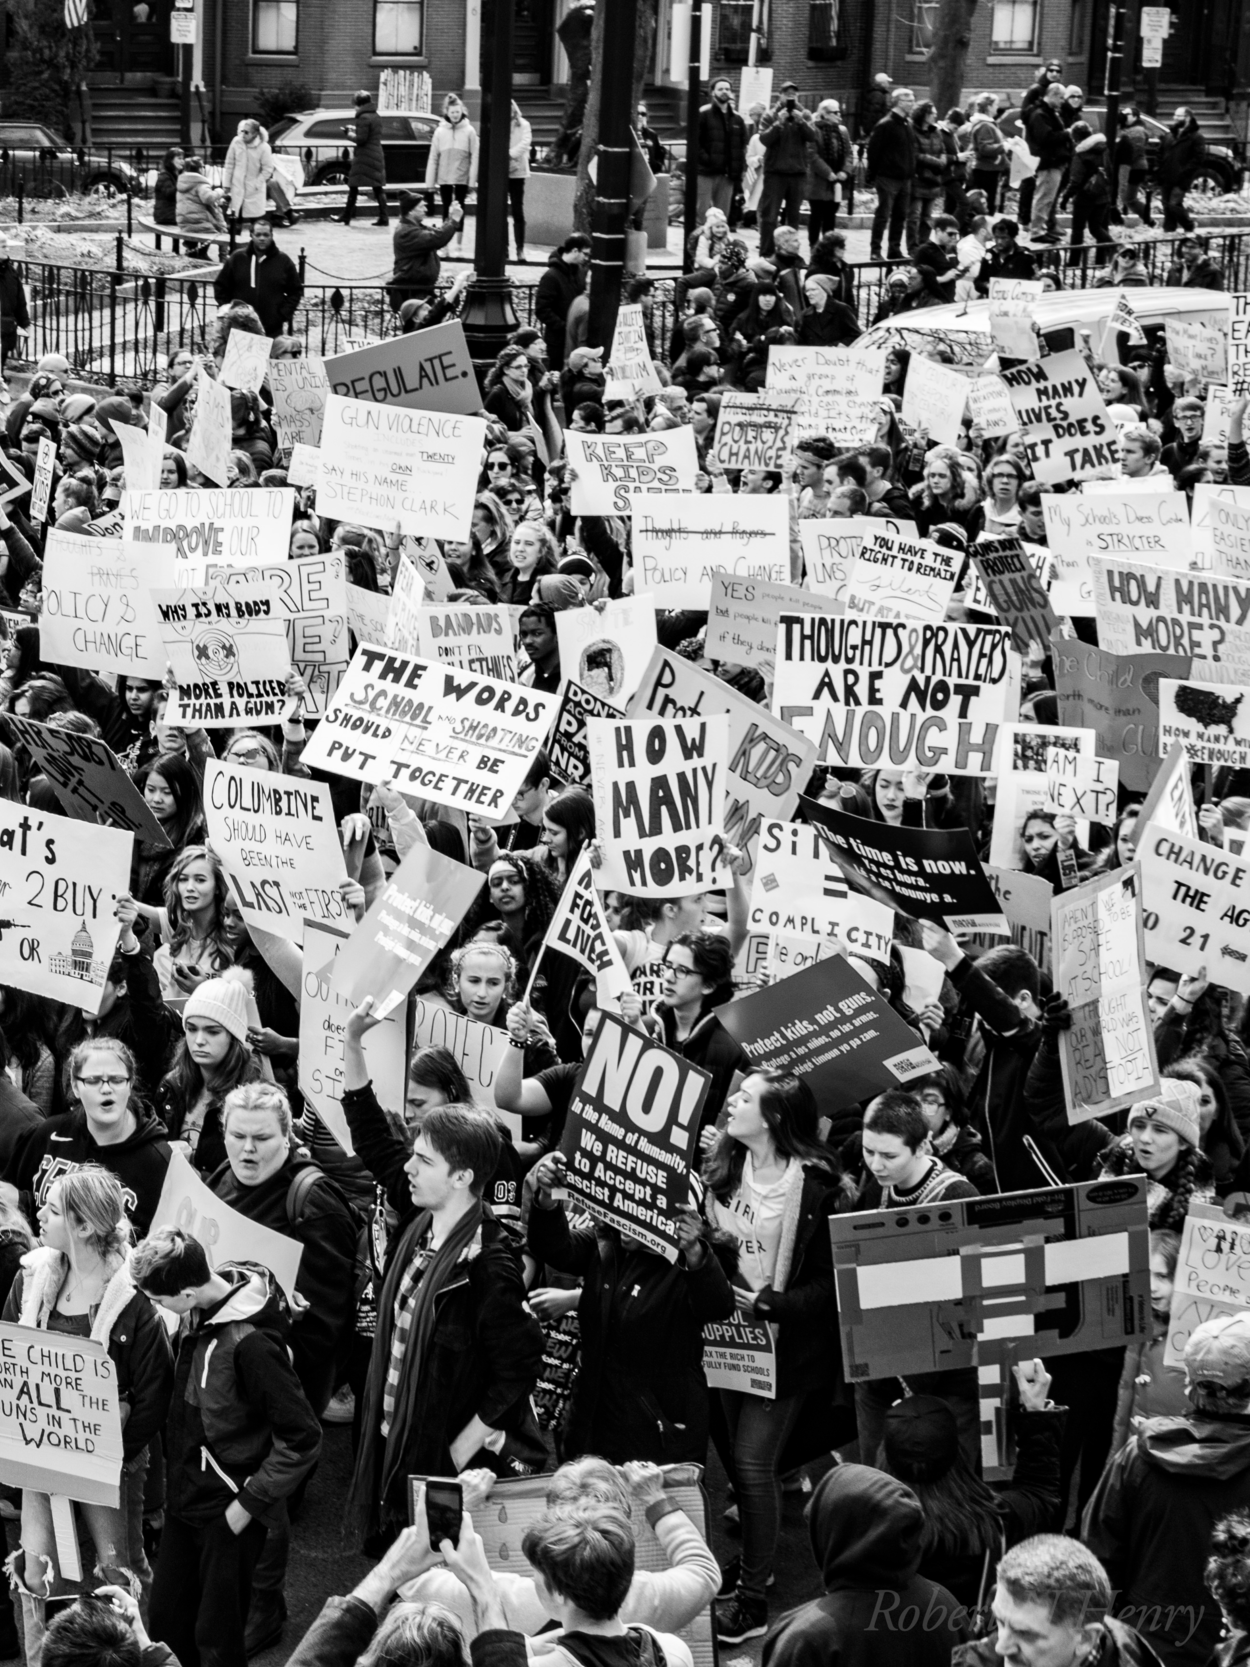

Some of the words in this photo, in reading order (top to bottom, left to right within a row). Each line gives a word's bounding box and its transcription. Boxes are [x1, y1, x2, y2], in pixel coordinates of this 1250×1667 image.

[333, 350, 469, 400] REGULATE.
[1003, 364, 1049, 387] HOW
[1036, 377, 1088, 403] MANY
[341, 405, 380, 430] GUN
[387, 413, 463, 438] VIOLENCE
[1018, 402, 1070, 426] LIVES
[1053, 415, 1106, 440] DOES
[391, 462, 412, 473] OWN
[419, 451, 455, 462] TWENTY
[582, 440, 668, 464] KEEP
[1028, 440, 1053, 463] IT
[1065, 440, 1121, 472] TAKE
[323, 463, 344, 477] SAY
[351, 469, 368, 483] HIS
[599, 464, 679, 486] KIDS
[325, 481, 395, 509] STEPHON
[401, 496, 459, 520] CLARK
[859, 546, 898, 568] RIGHT
[900, 557, 913, 571] TO
[916, 564, 956, 582] REMAIN
[873, 535, 894, 551] YOU
[900, 543, 927, 560] HAVE
[933, 552, 953, 568] THE
[721, 581, 755, 602] YES
[762, 590, 785, 601] people
[1107, 569, 1162, 609] HOW
[1174, 578, 1250, 626] MANY
[157, 602, 191, 622] WHY
[195, 602, 211, 617] IS
[215, 602, 232, 616] MY
[236, 600, 271, 618] BODY
[716, 606, 729, 616] but
[734, 610, 760, 622] people
[780, 615, 906, 668] THOUGHTS
[900, 628, 922, 674] &
[920, 624, 1011, 683] PRAYERS
[1132, 615, 1225, 661] MORE?
[179, 682, 223, 701] MORE
[228, 680, 288, 698] POLICED
[361, 649, 428, 690] THE
[443, 674, 545, 722] WORDS
[812, 668, 884, 707] ARE
[899, 674, 980, 720] NOT
[179, 702, 223, 719] THAN
[229, 701, 240, 717] A
[245, 700, 285, 717] GUN?
[350, 683, 434, 726] SCHOOL
[437, 714, 455, 724] AND
[453, 717, 539, 752] SHOOTING
[325, 709, 391, 739] SHOULD
[401, 733, 469, 764] NEVER
[476, 755, 505, 774] BE
[614, 721, 707, 768] HOW
[327, 741, 377, 770] PUT
[389, 760, 504, 809] TOGETHER
[211, 770, 323, 822] COLUMBINE
[612, 763, 717, 839] MANY
[223, 817, 266, 844] SHOULD
[275, 831, 315, 851] HAVE
[813, 821, 848, 848] The
[850, 837, 895, 866] time
[899, 852, 918, 872] is
[922, 859, 976, 875] now.
[623, 835, 723, 888] MORE?
[862, 858, 878, 873] Ya
[880, 866, 894, 877] es
[897, 870, 930, 887] hora.
[1154, 837, 1247, 887] CHANGE
[26, 871, 45, 908] 2
[53, 879, 102, 919] BUY
[229, 873, 292, 918] LAST
[305, 888, 349, 920] FIRST
[1172, 879, 1211, 912] THE
[20, 939, 41, 963] OR
[1178, 926, 1210, 951] 21
[741, 1032, 787, 1058] Protect
[781, 1020, 819, 1041] kids,
[814, 1005, 840, 1026] not
[838, 992, 875, 1015] guns.
[581, 1018, 705, 1150] NO!
[571, 1097, 583, 1114] In
[582, 1104, 599, 1124] the
[598, 1113, 625, 1139] Name
[625, 1132, 638, 1146] of
[637, 1138, 686, 1175] Humanity,
[580, 1128, 603, 1156] We
[606, 1144, 667, 1189] REFUSE
[574, 1151, 590, 1172] to
[594, 1162, 652, 1202] Accept
[657, 1194, 667, 1209] a
[568, 1191, 667, 1254] RefuseFascism.org
[27, 1345, 85, 1373] CHILD
[95, 1359, 110, 1378] IS
[715, 1351, 728, 1360] THE
[729, 1352, 745, 1361] RICH
[746, 1354, 755, 1363] TO
[723, 1363, 741, 1371] FUND
[743, 1365, 770, 1377] SCHOOLS
[16, 1381, 72, 1413] ALL
[79, 1394, 110, 1412] THE
[41, 1371, 84, 1392] MORE
[19, 1423, 95, 1453] WORLD
[47, 1413, 61, 1429] IN
[69, 1417, 101, 1436] THE
